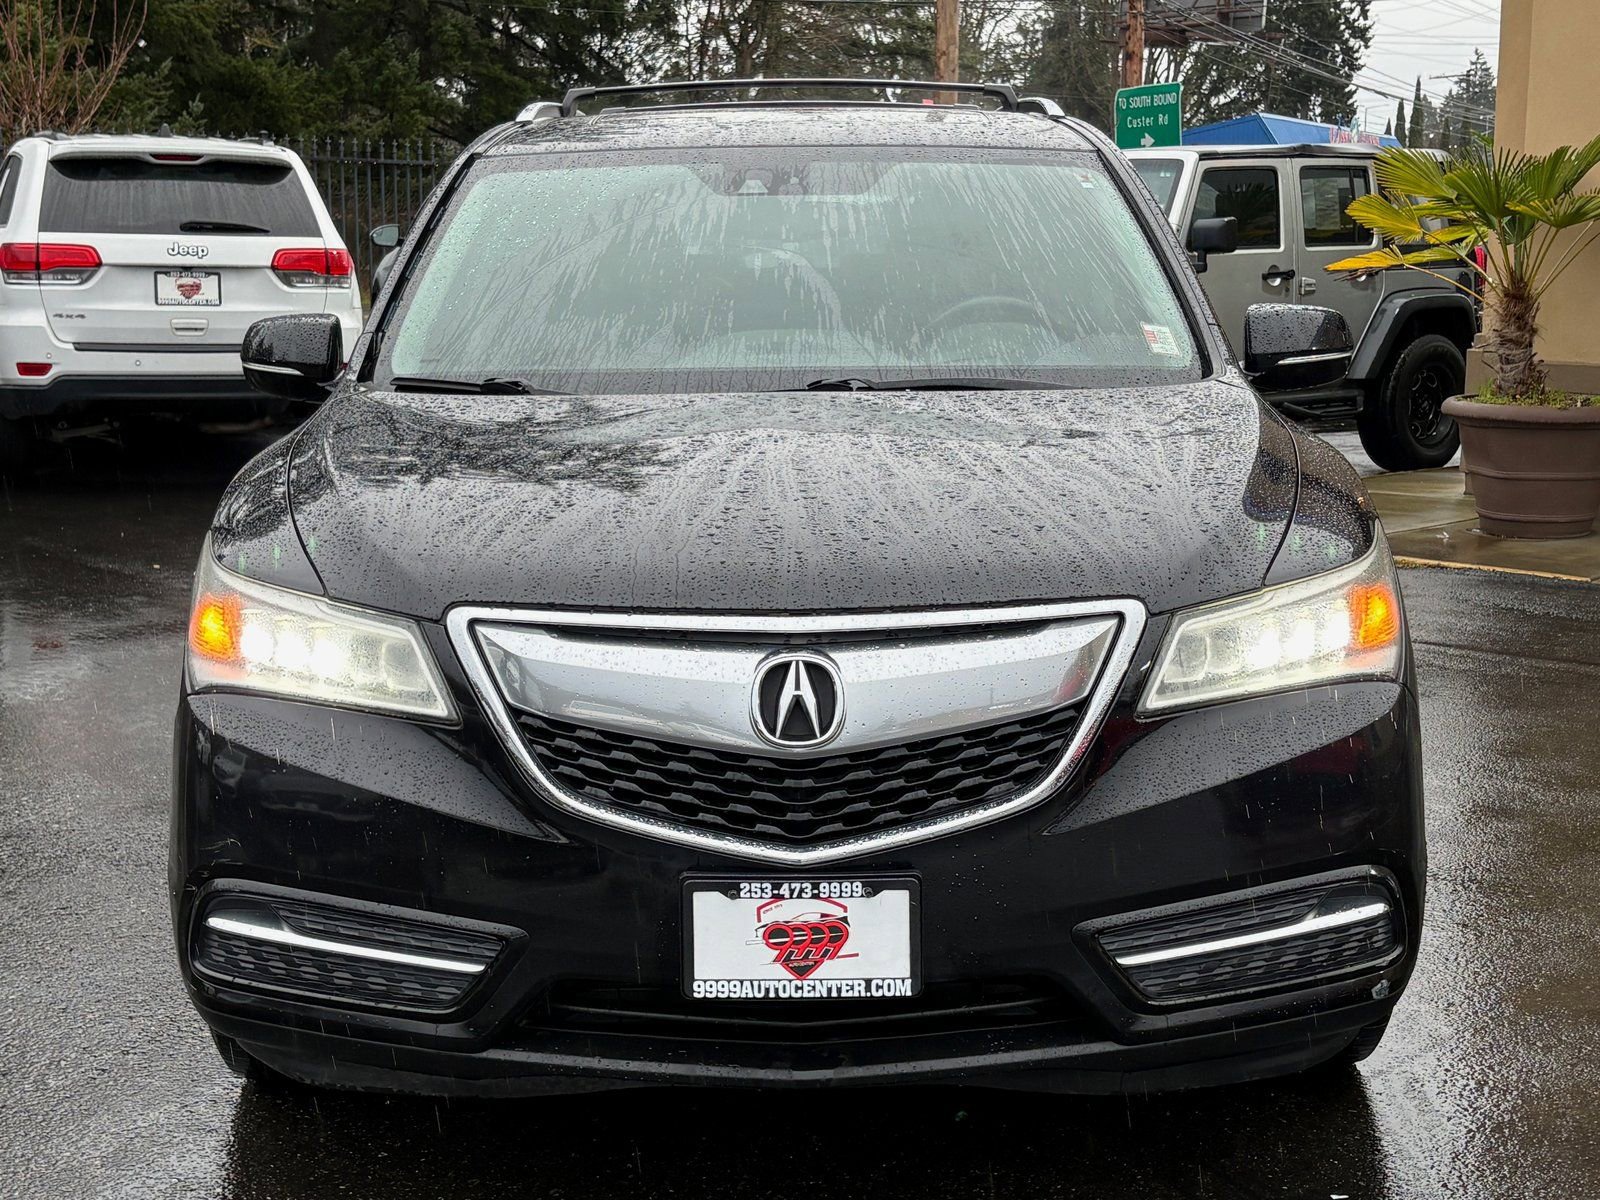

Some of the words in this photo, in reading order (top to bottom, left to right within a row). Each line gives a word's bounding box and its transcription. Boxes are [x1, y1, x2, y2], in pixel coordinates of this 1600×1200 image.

[1119, 98, 1127, 109] TO
[1129, 95, 1151, 109] SOUTH
[1153, 92, 1177, 106] BOUND
[1127, 116, 1154, 128] Custer
[1158, 114, 1169, 125] Rd
[167, 242, 209, 259] Jeep
[739, 882, 862, 899] 253-473-9999
[693, 978, 912, 998] 9999AUTOCENTER.COM
